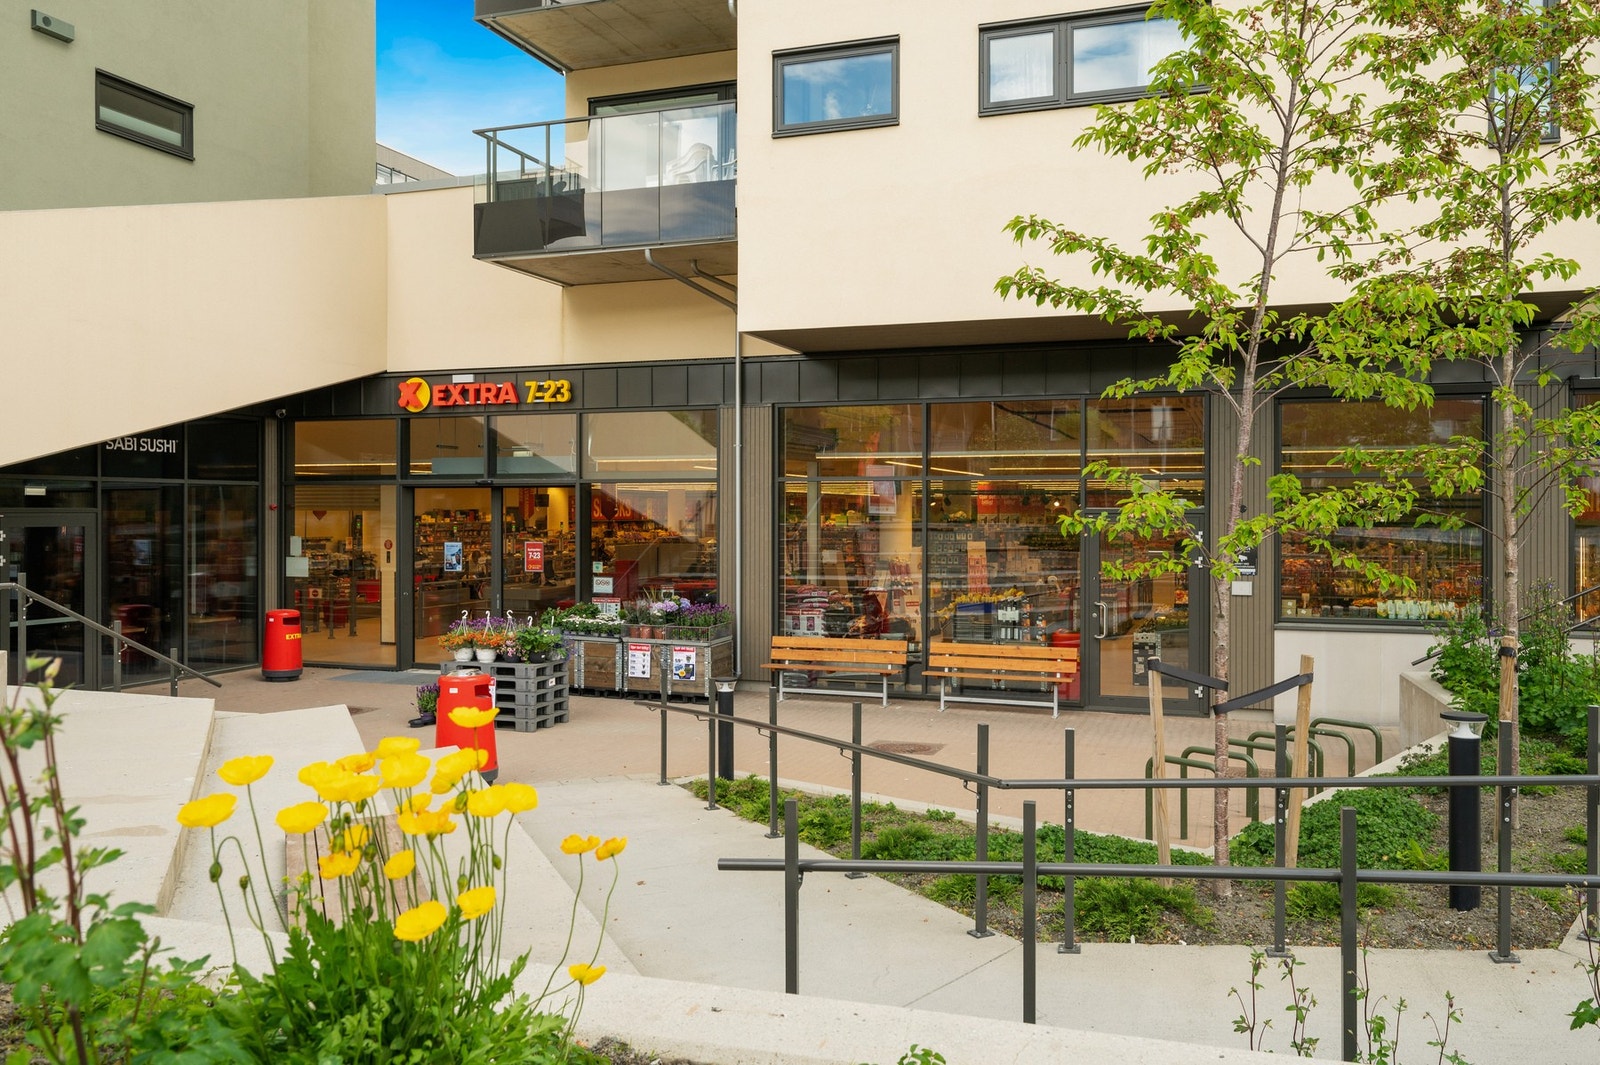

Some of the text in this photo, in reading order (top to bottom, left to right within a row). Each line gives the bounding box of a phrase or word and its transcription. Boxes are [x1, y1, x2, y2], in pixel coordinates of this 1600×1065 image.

[432, 382, 519, 406] EXTRA
[524, 379, 572, 403] 7-23
[106, 437, 176, 453] SABI SUSHI
